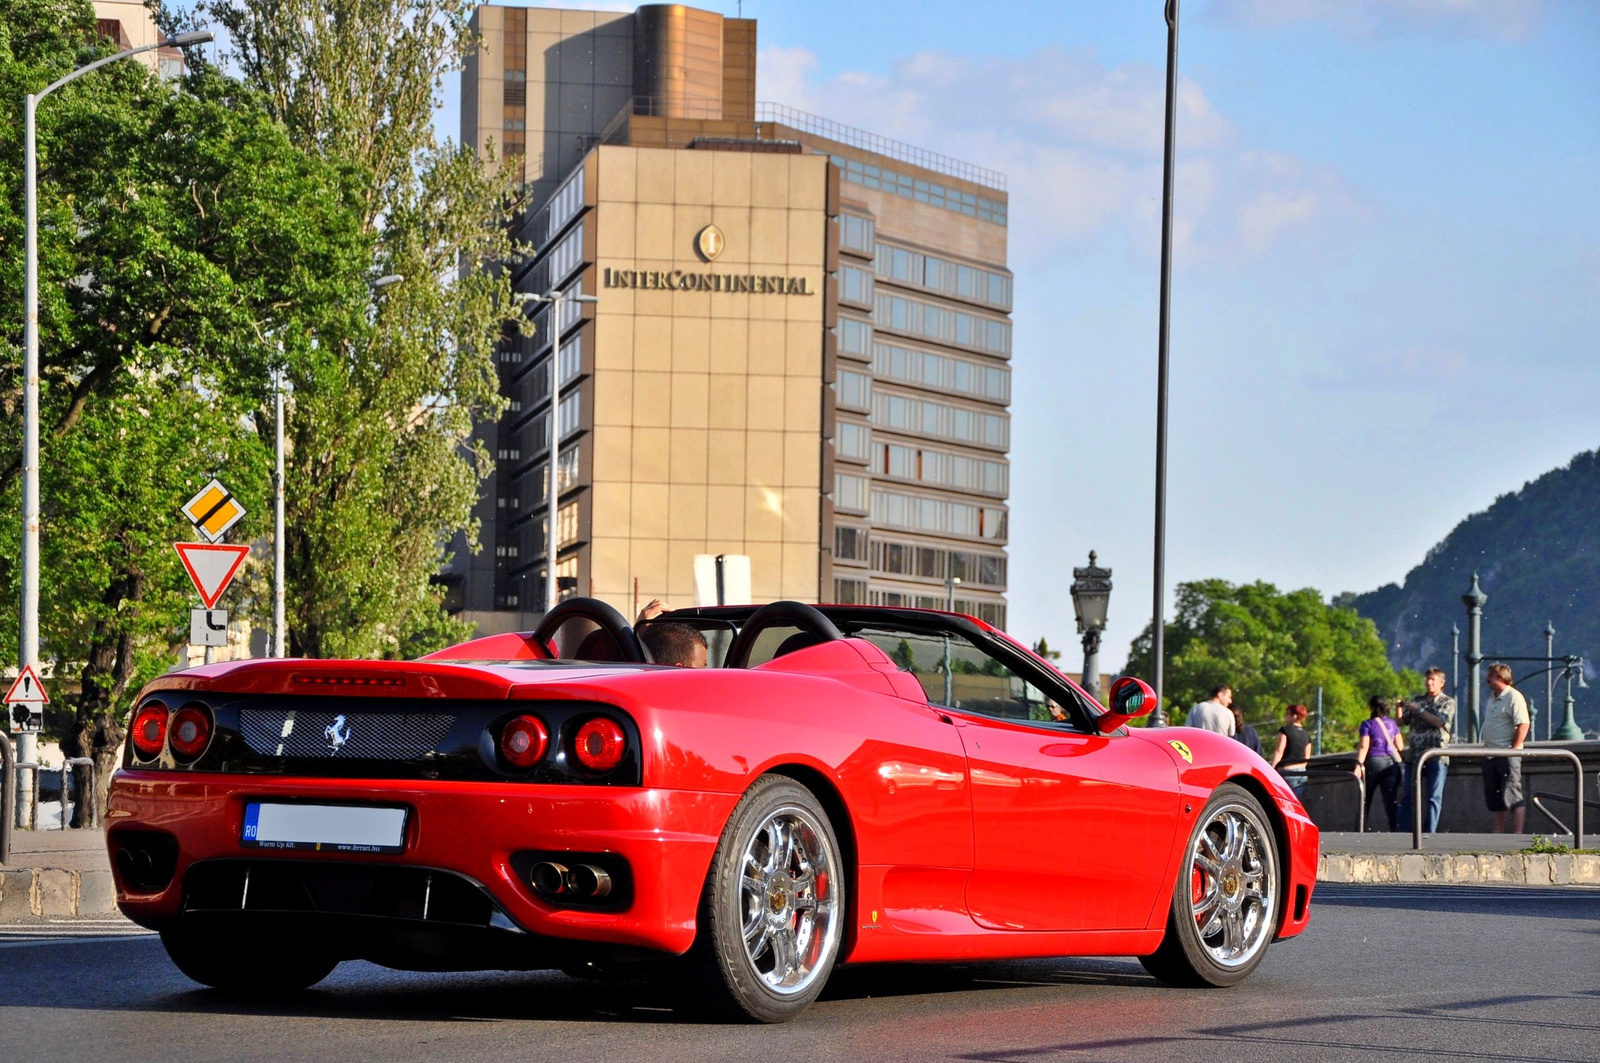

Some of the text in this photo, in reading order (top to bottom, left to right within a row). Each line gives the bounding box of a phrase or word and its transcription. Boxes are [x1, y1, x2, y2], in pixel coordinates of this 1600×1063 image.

[245, 824, 257, 837] RO
[276, 841, 285, 849] Up
[339, 844, 380, 852] www.ferrari.hu
